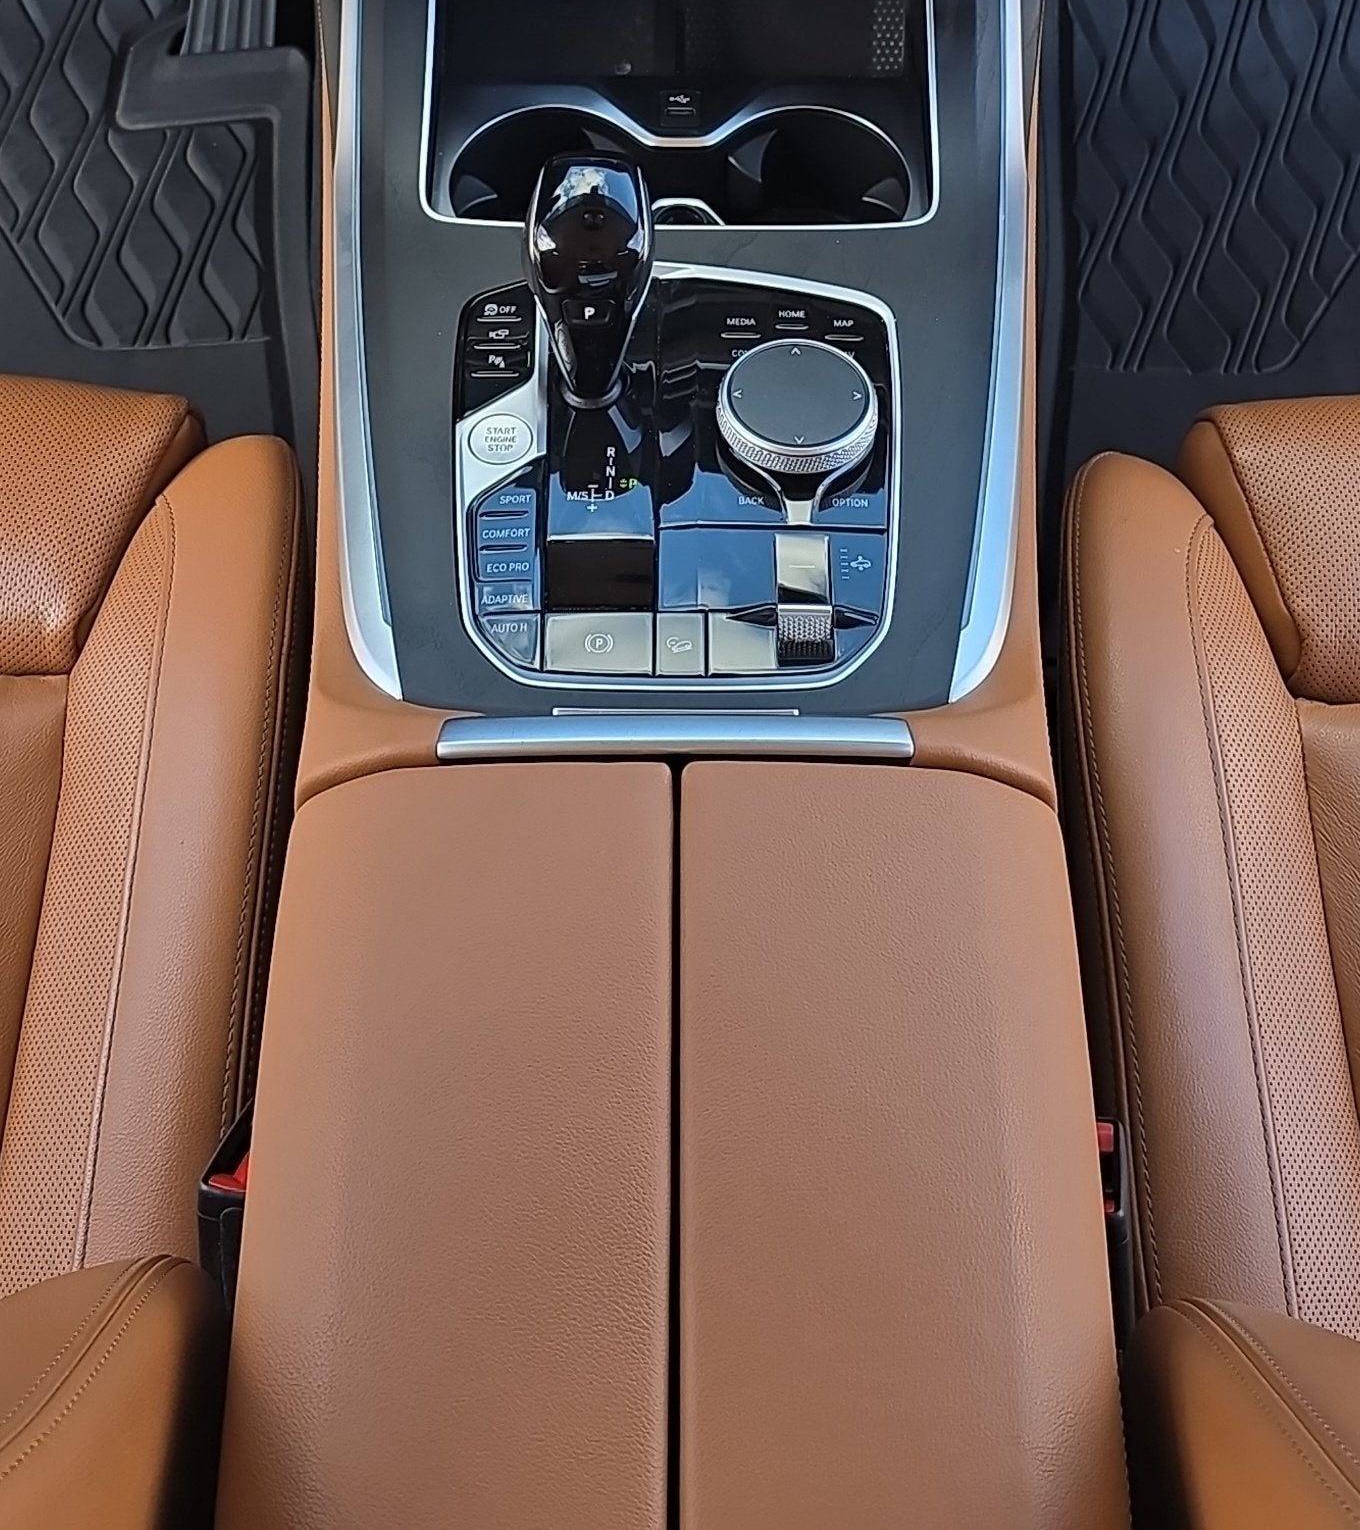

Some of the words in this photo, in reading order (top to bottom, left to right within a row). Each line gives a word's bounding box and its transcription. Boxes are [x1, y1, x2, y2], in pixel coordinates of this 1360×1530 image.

[499, 306, 517, 314] OFF
[584, 307, 595, 320] P
[778, 310, 805, 319] HOME
[726, 318, 756, 326] MEDIA
[833, 319, 854, 328] MAP
[486, 426, 516, 435] START
[485, 435, 517, 444] ENGINE
[487, 444, 514, 453] STOP
[606, 446, 616, 457] R
[606, 466, 616, 477] N
[629, 478, 638, 489] P
[499, 494, 532, 505] SPORT
[567, 491, 589, 501] M/S
[605, 490, 615, 500] D
[738, 496, 765, 506] BACK
[832, 497, 869, 508] OPTION
[482, 527, 531, 539] COMFORT
[486, 563, 507, 573] ECO
[509, 562, 530, 572] PRO
[481, 594, 529, 605] ADAPTIVE
[491, 623, 518, 635] AUTO
[519, 622, 528, 633] H
